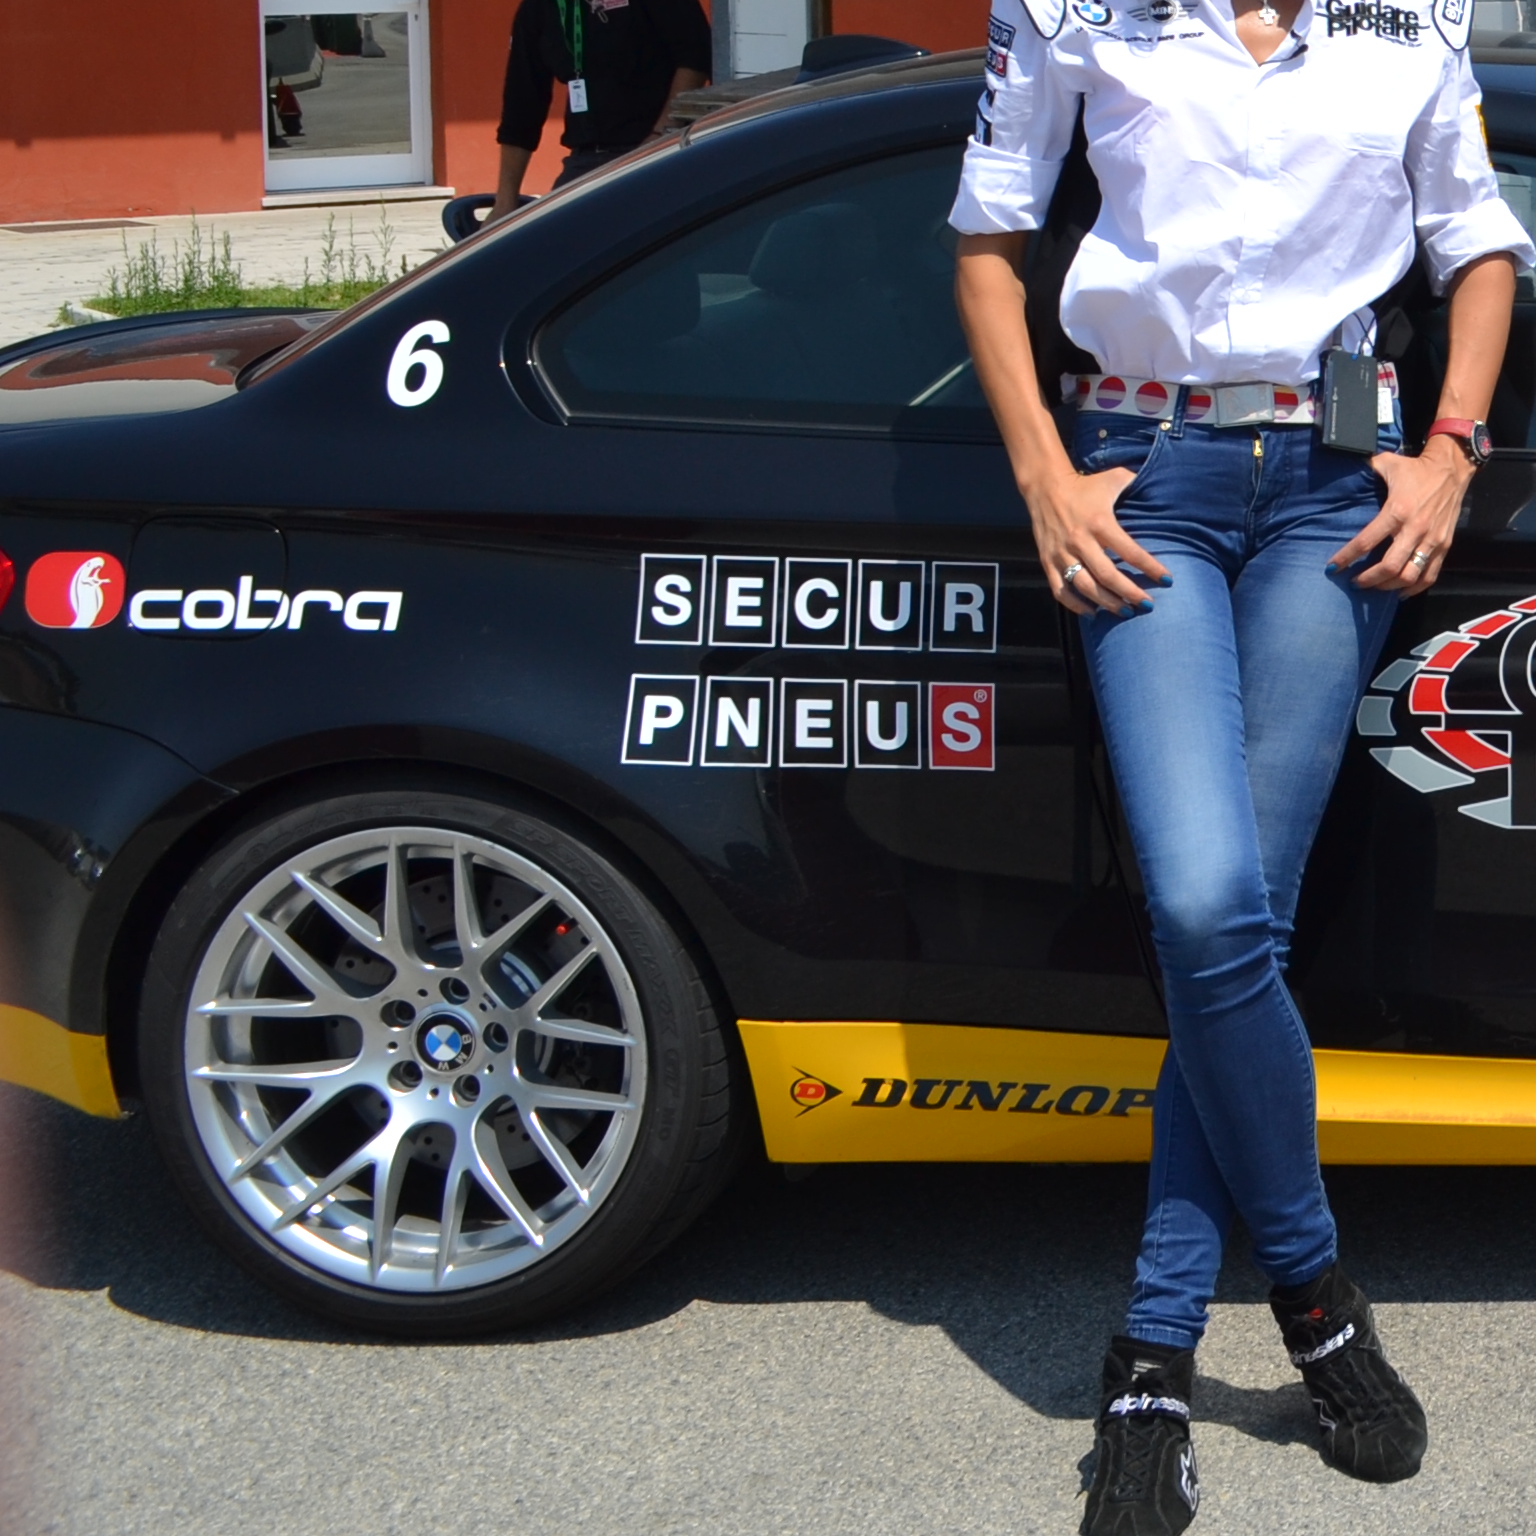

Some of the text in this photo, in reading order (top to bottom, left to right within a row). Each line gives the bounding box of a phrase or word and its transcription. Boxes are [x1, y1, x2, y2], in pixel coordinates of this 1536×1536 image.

[1327, 16, 1420, 42] Pilotare
[386, 320, 451, 408] 6
[129, 575, 404, 632] cobra
[645, 568, 990, 640] SECUR
[632, 688, 988, 759] PNEUS
[852, 1077, 1156, 1118] DUNLOP
